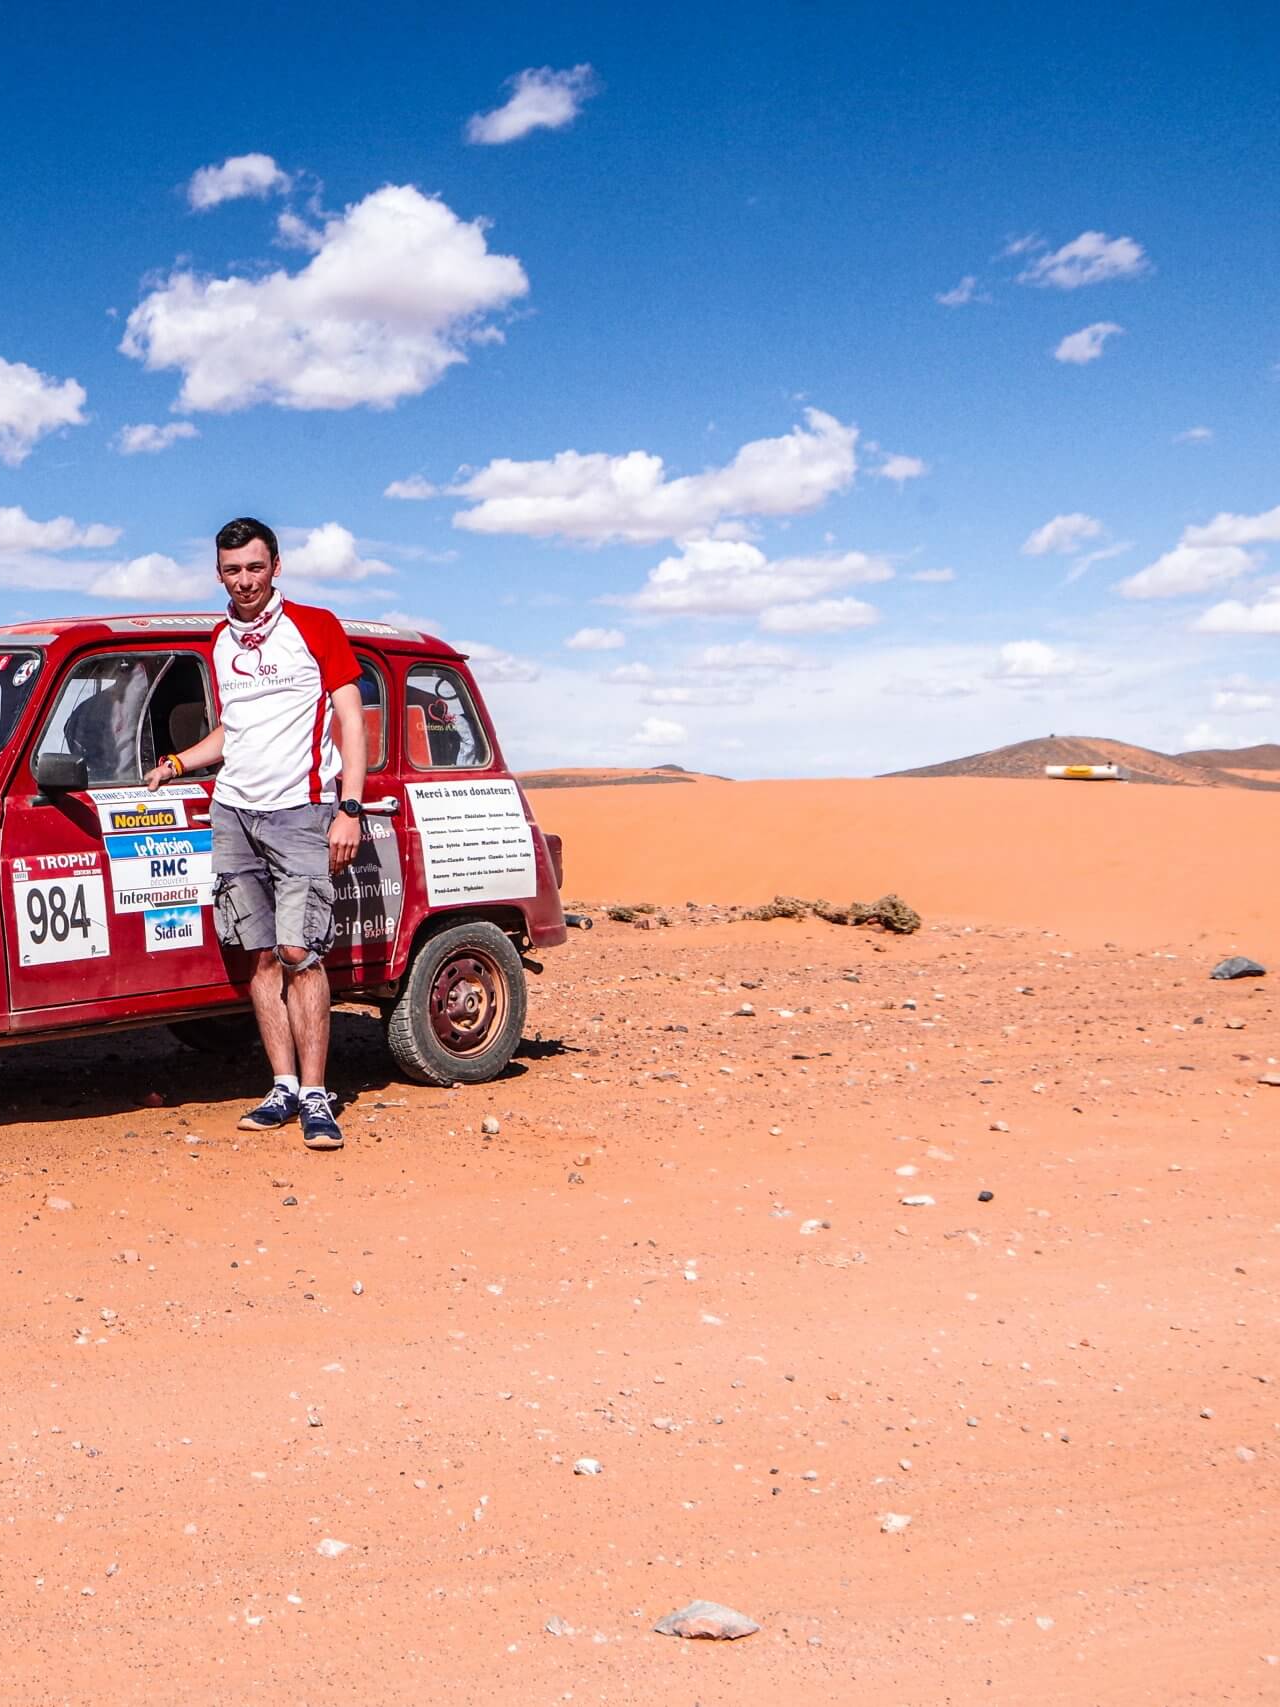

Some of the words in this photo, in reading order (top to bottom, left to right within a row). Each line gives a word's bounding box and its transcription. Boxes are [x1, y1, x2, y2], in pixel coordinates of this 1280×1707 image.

[259, 663, 278, 676] SOS
[92, 791, 125, 801] RENNES
[125, 789, 156, 800] SCHOOL
[157, 789, 167, 797] OF
[166, 787, 205, 797] BUSINESS
[415, 789, 443, 799] Merci
[445, 788, 451, 798] à
[452, 788, 468, 797] nos
[114, 813, 174, 828] Norauto
[13, 857, 32, 871] 4L
[37, 852, 97, 870] TROPHY
[151, 858, 188, 878] RMC
[120, 886, 199, 906] Intermarché
[332, 879, 401, 901] outainville
[27, 883, 92, 945] 984
[154, 925, 176, 941] Sidi
[178, 923, 192, 937] ali
[334, 915, 395, 937] cinelle
